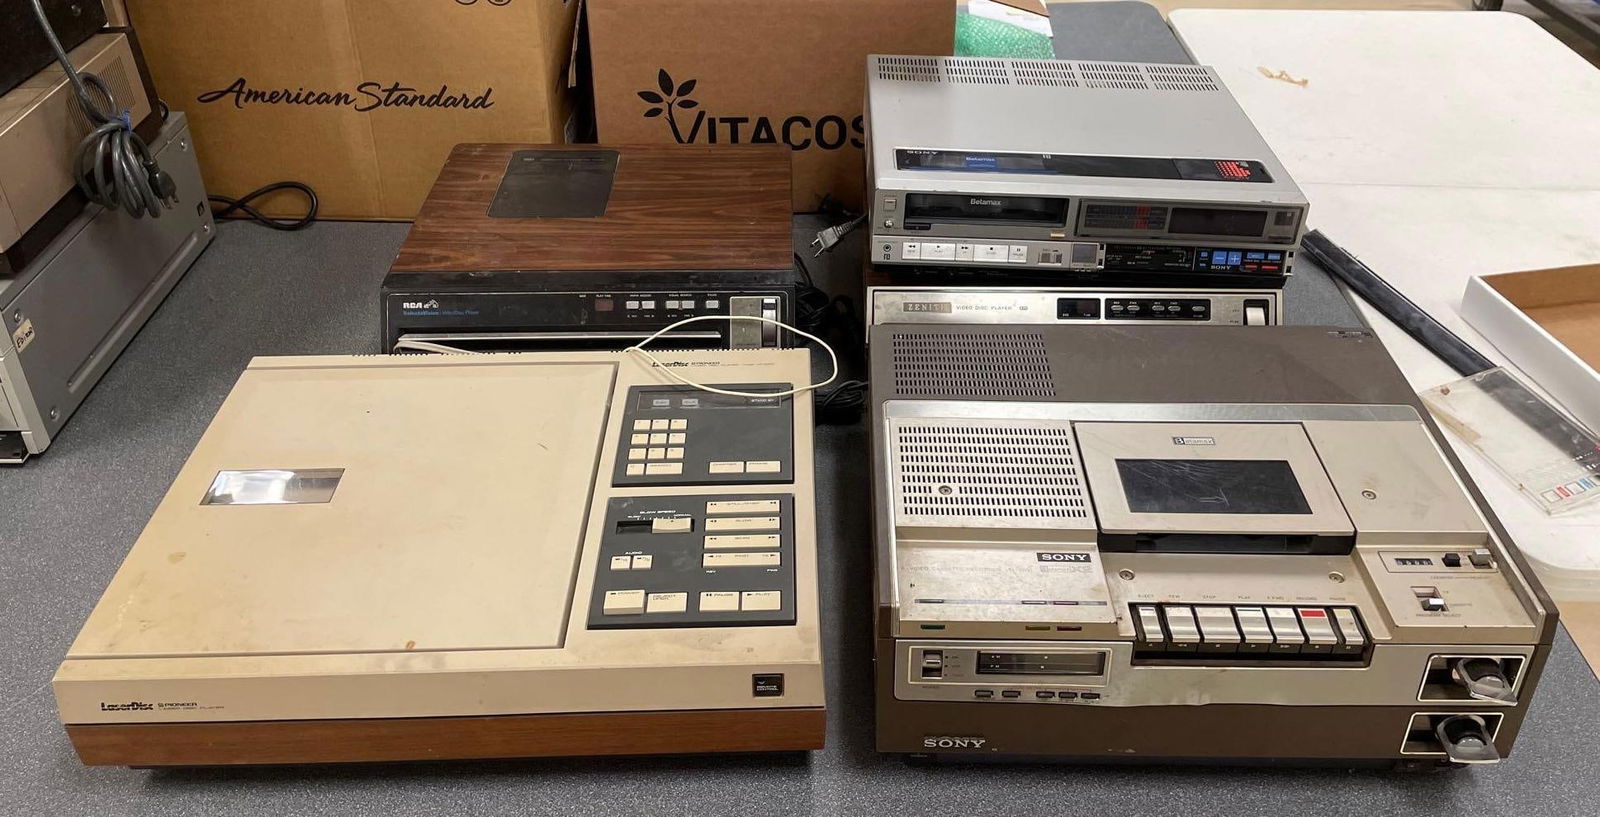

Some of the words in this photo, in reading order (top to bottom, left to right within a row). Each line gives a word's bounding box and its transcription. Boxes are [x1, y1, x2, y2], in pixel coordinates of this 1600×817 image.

[197, 77, 356, 109] American
[354, 81, 495, 112] Standard
[970, 198, 1002, 206] Betamax
[1041, 553, 1087, 561] SONY
[101, 702, 154, 711] LaserDisc
[924, 738, 986, 748] SONY
